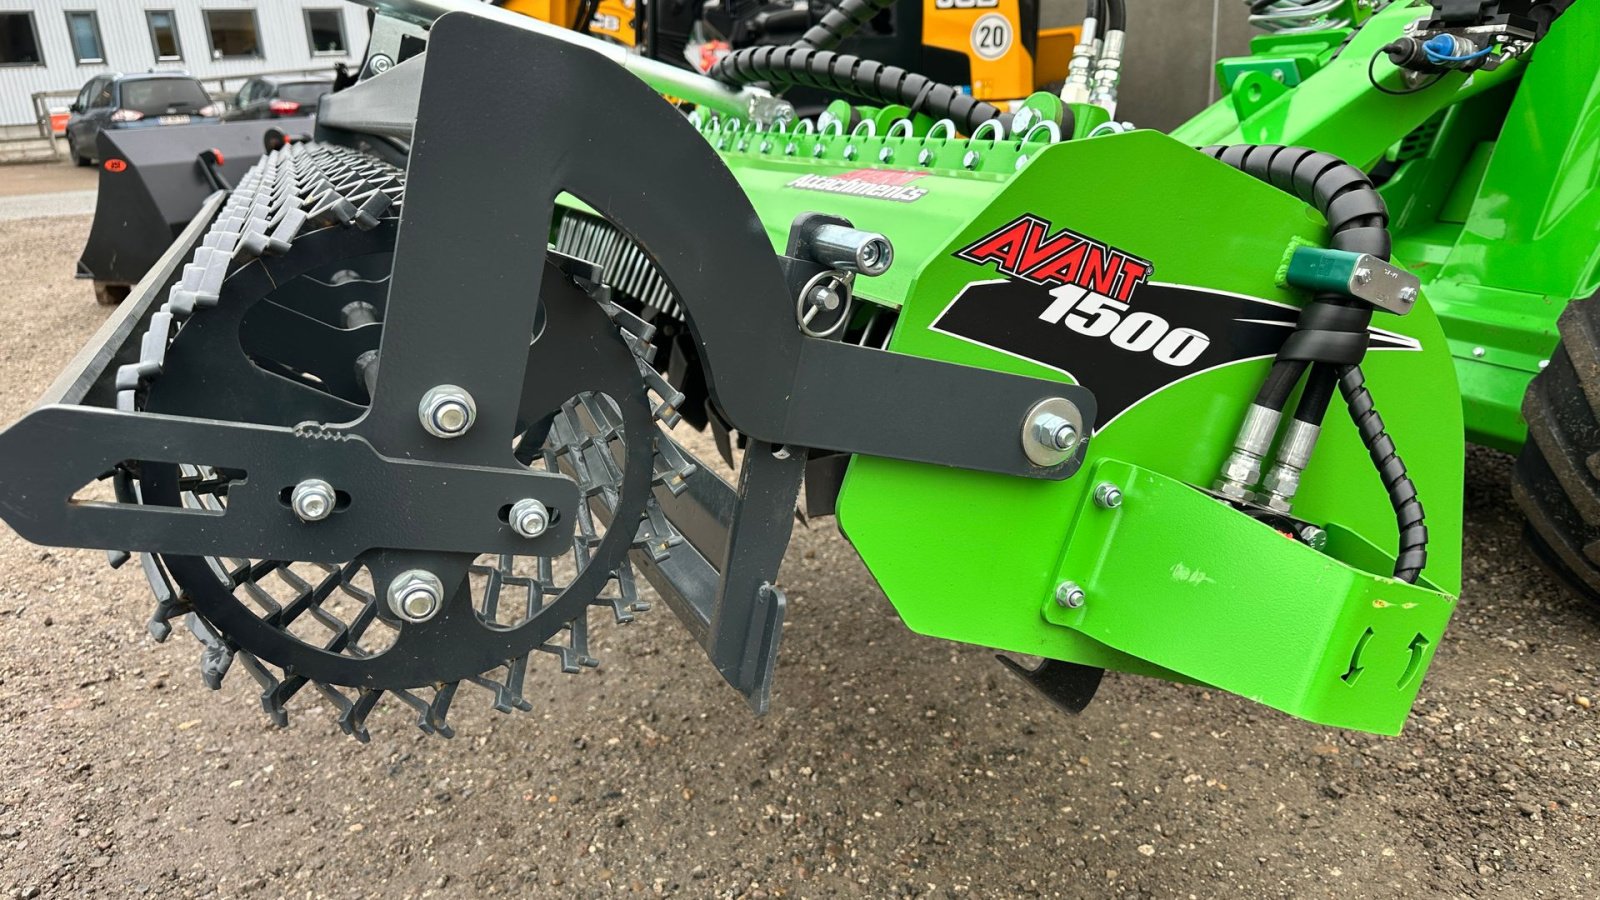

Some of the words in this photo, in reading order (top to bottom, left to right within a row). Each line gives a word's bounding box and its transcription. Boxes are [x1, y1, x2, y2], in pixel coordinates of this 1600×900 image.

[980, 26, 1004, 48] 20
[786, 173, 929, 202] Attachments
[957, 215, 1150, 304] AVANT
[1038, 283, 1211, 367] 1500
